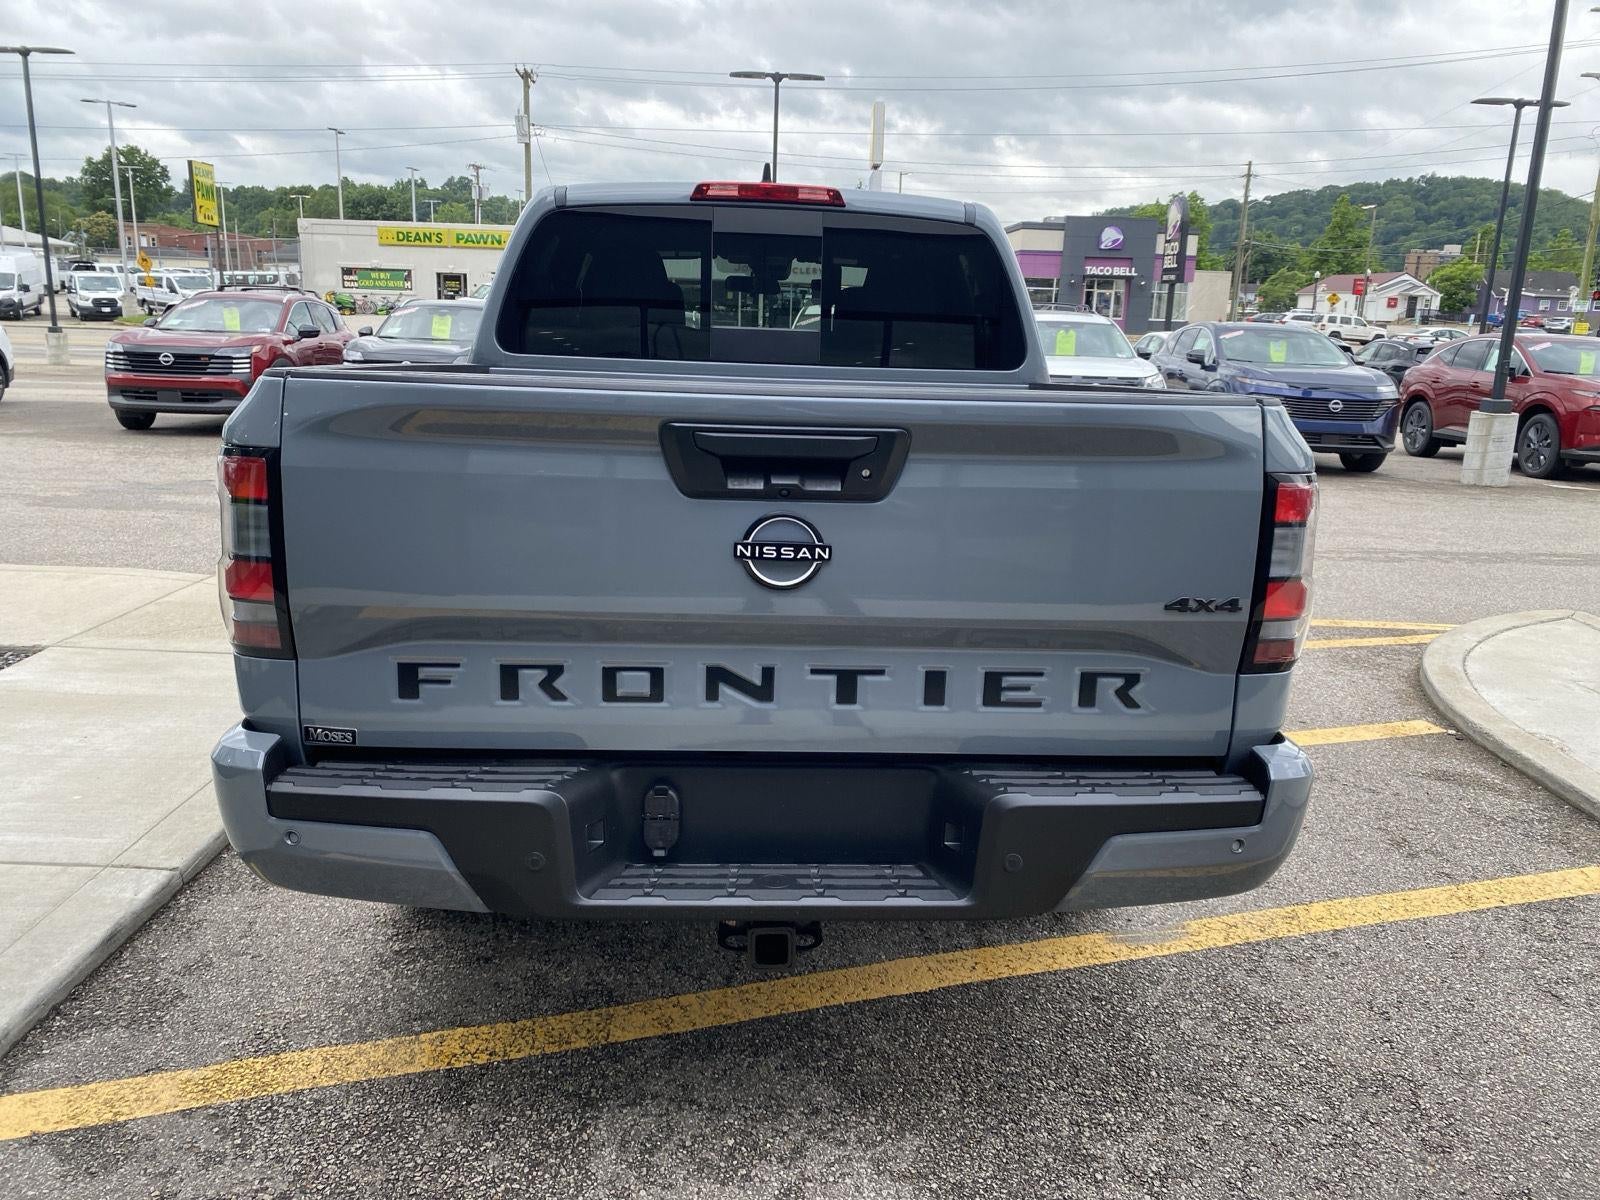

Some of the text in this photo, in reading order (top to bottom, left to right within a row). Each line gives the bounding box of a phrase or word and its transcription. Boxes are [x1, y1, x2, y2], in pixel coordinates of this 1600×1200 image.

[196, 179, 215, 202] PAWN
[396, 231, 502, 245] DEAN'S PAWN
[1164, 241, 1179, 256] TACO
[1163, 255, 1178, 269] BELL
[380, 272, 391, 280] BUY
[1085, 266, 1138, 276] TACO BELL
[736, 545, 829, 560] NISSAN
[396, 660, 1142, 710] FRONTIER
